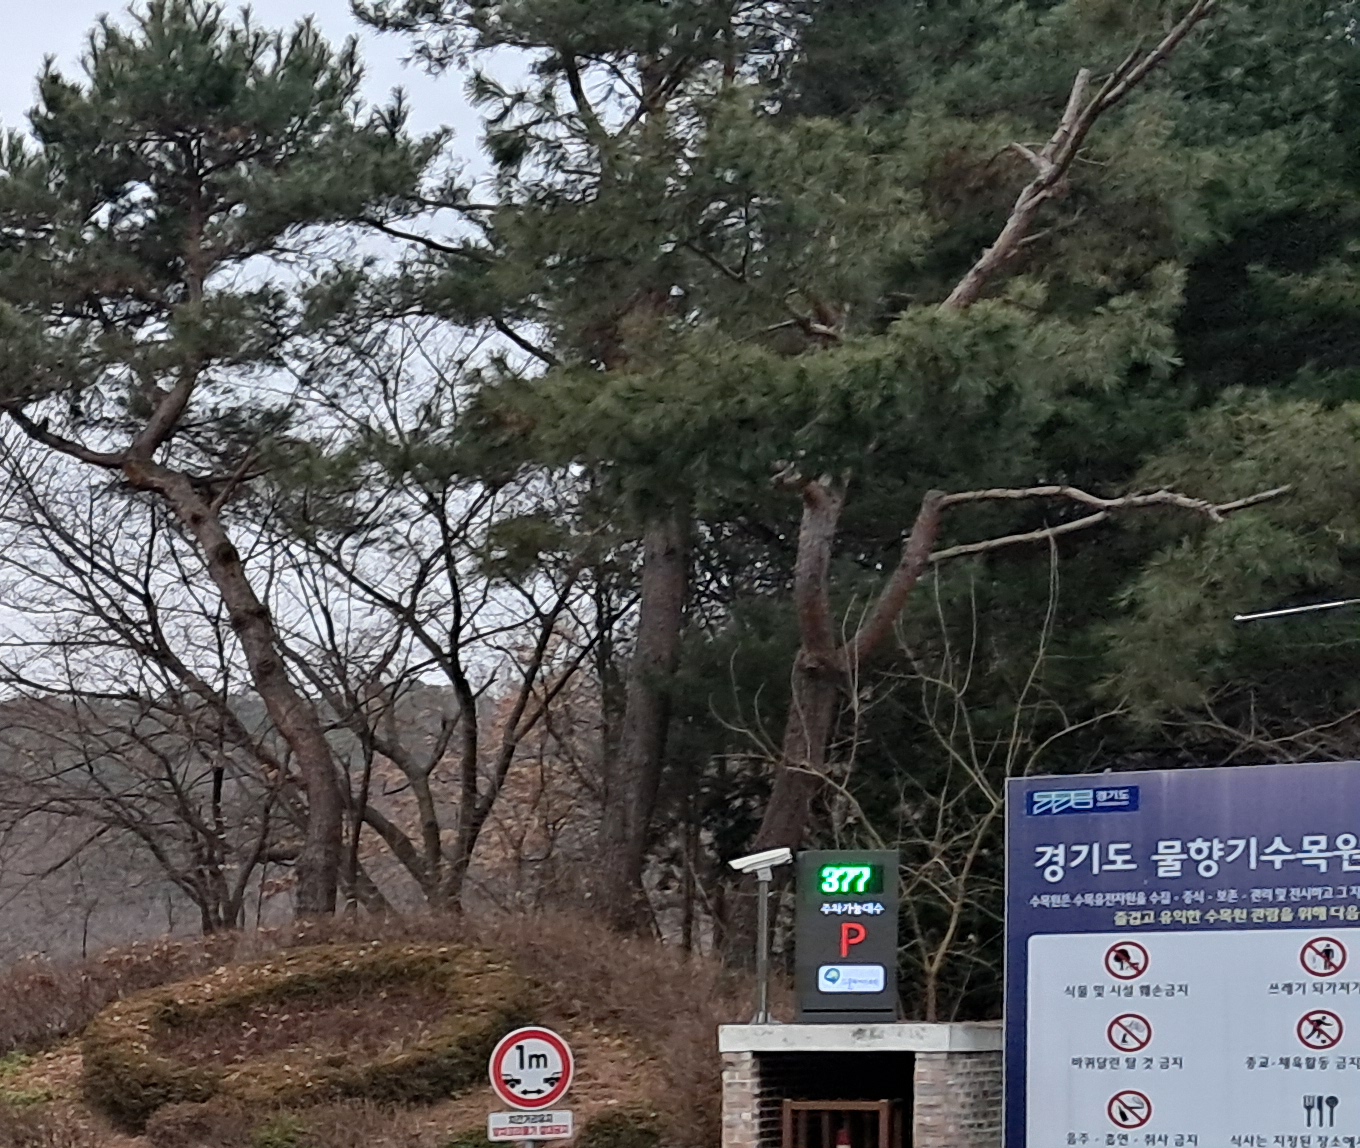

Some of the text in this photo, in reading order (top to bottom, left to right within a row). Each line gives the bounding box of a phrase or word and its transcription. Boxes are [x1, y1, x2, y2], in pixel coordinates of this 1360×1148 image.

[1033, 833, 1360, 882] 경기도 물향기수목원
[821, 866, 872, 893] 377
[1205, 908, 1247, 923] 수목원
[841, 922, 868, 958] P
[516, 1044, 548, 1070] 1m
[1160, 1056, 1183, 1070] 금지
[1174, 1133, 1198, 1148] 금지
